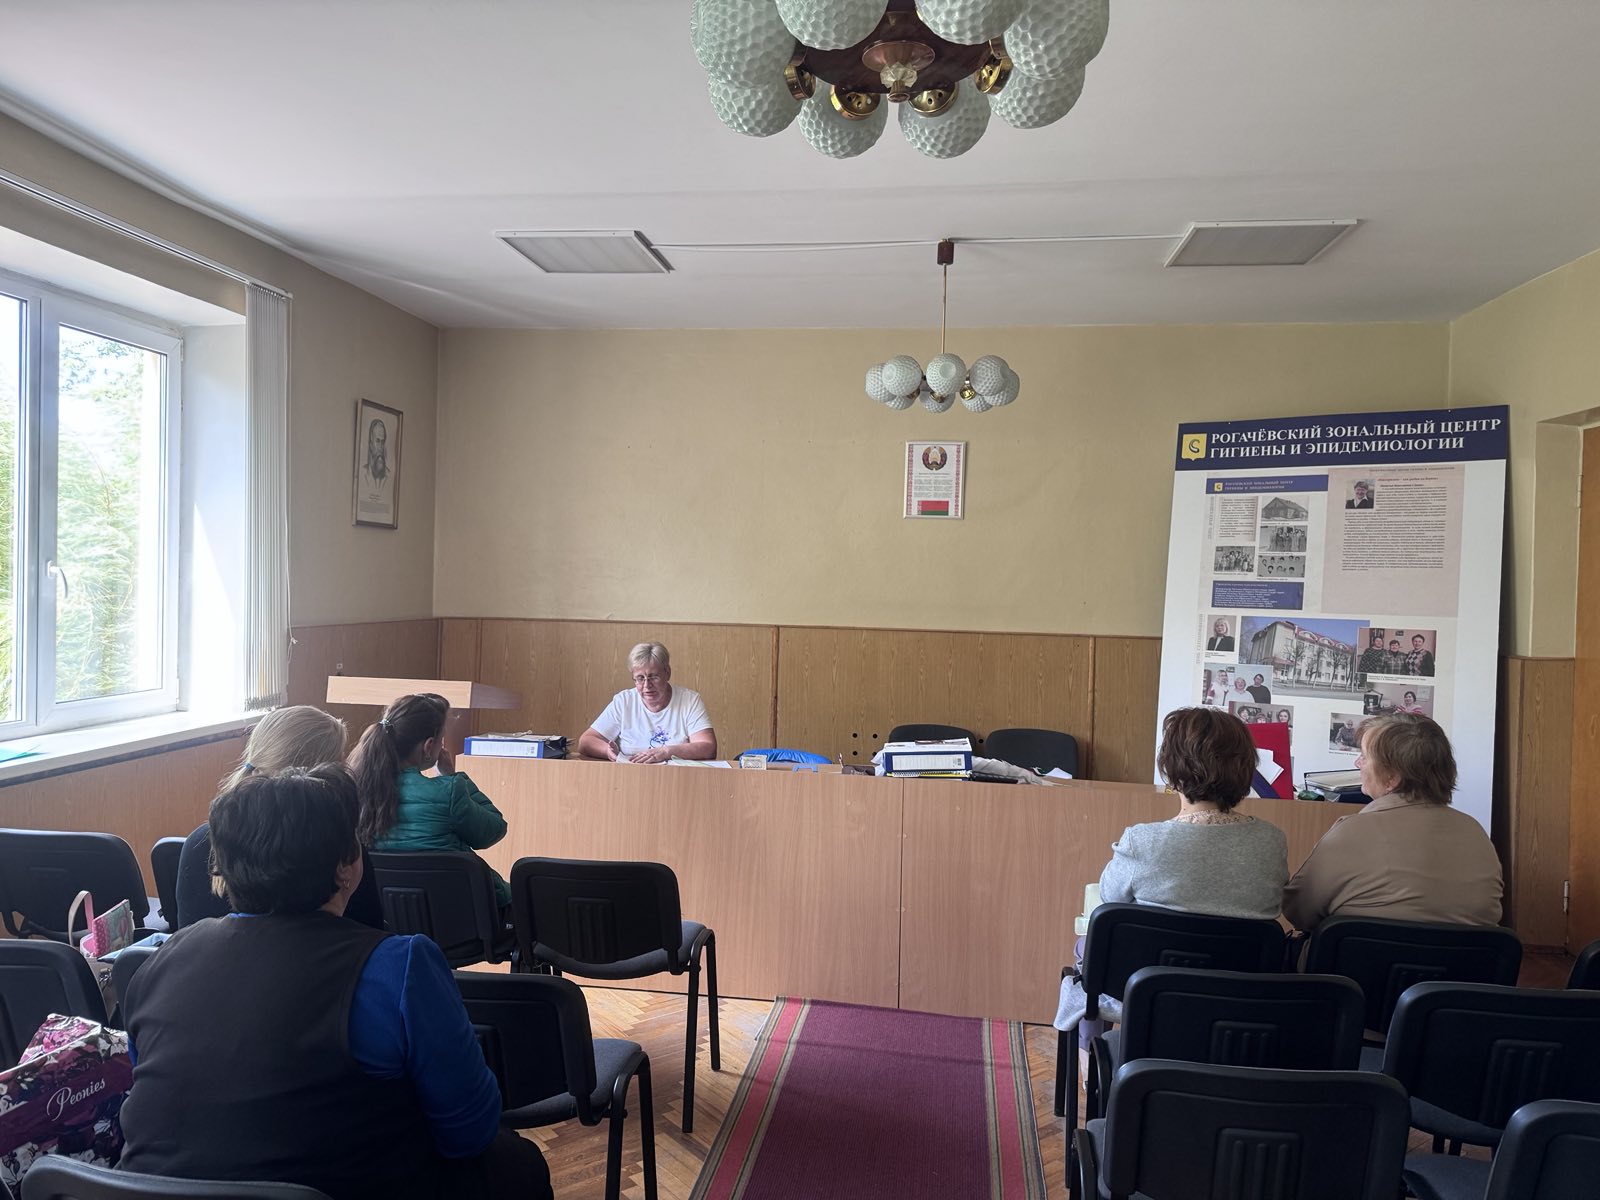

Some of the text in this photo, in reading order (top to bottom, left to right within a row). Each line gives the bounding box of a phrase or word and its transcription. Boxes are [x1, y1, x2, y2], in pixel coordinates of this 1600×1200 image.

[1211, 418, 1502, 444] РОГАЧЁВСКИЙ ЗОНАЛЬНЫЙ ЦЕНТР
[1210, 437, 1465, 458] ГИГИЕНЫ И ЭПИДЕМИОЛОГИИ
[46, 1078, 106, 1122] Peonies
